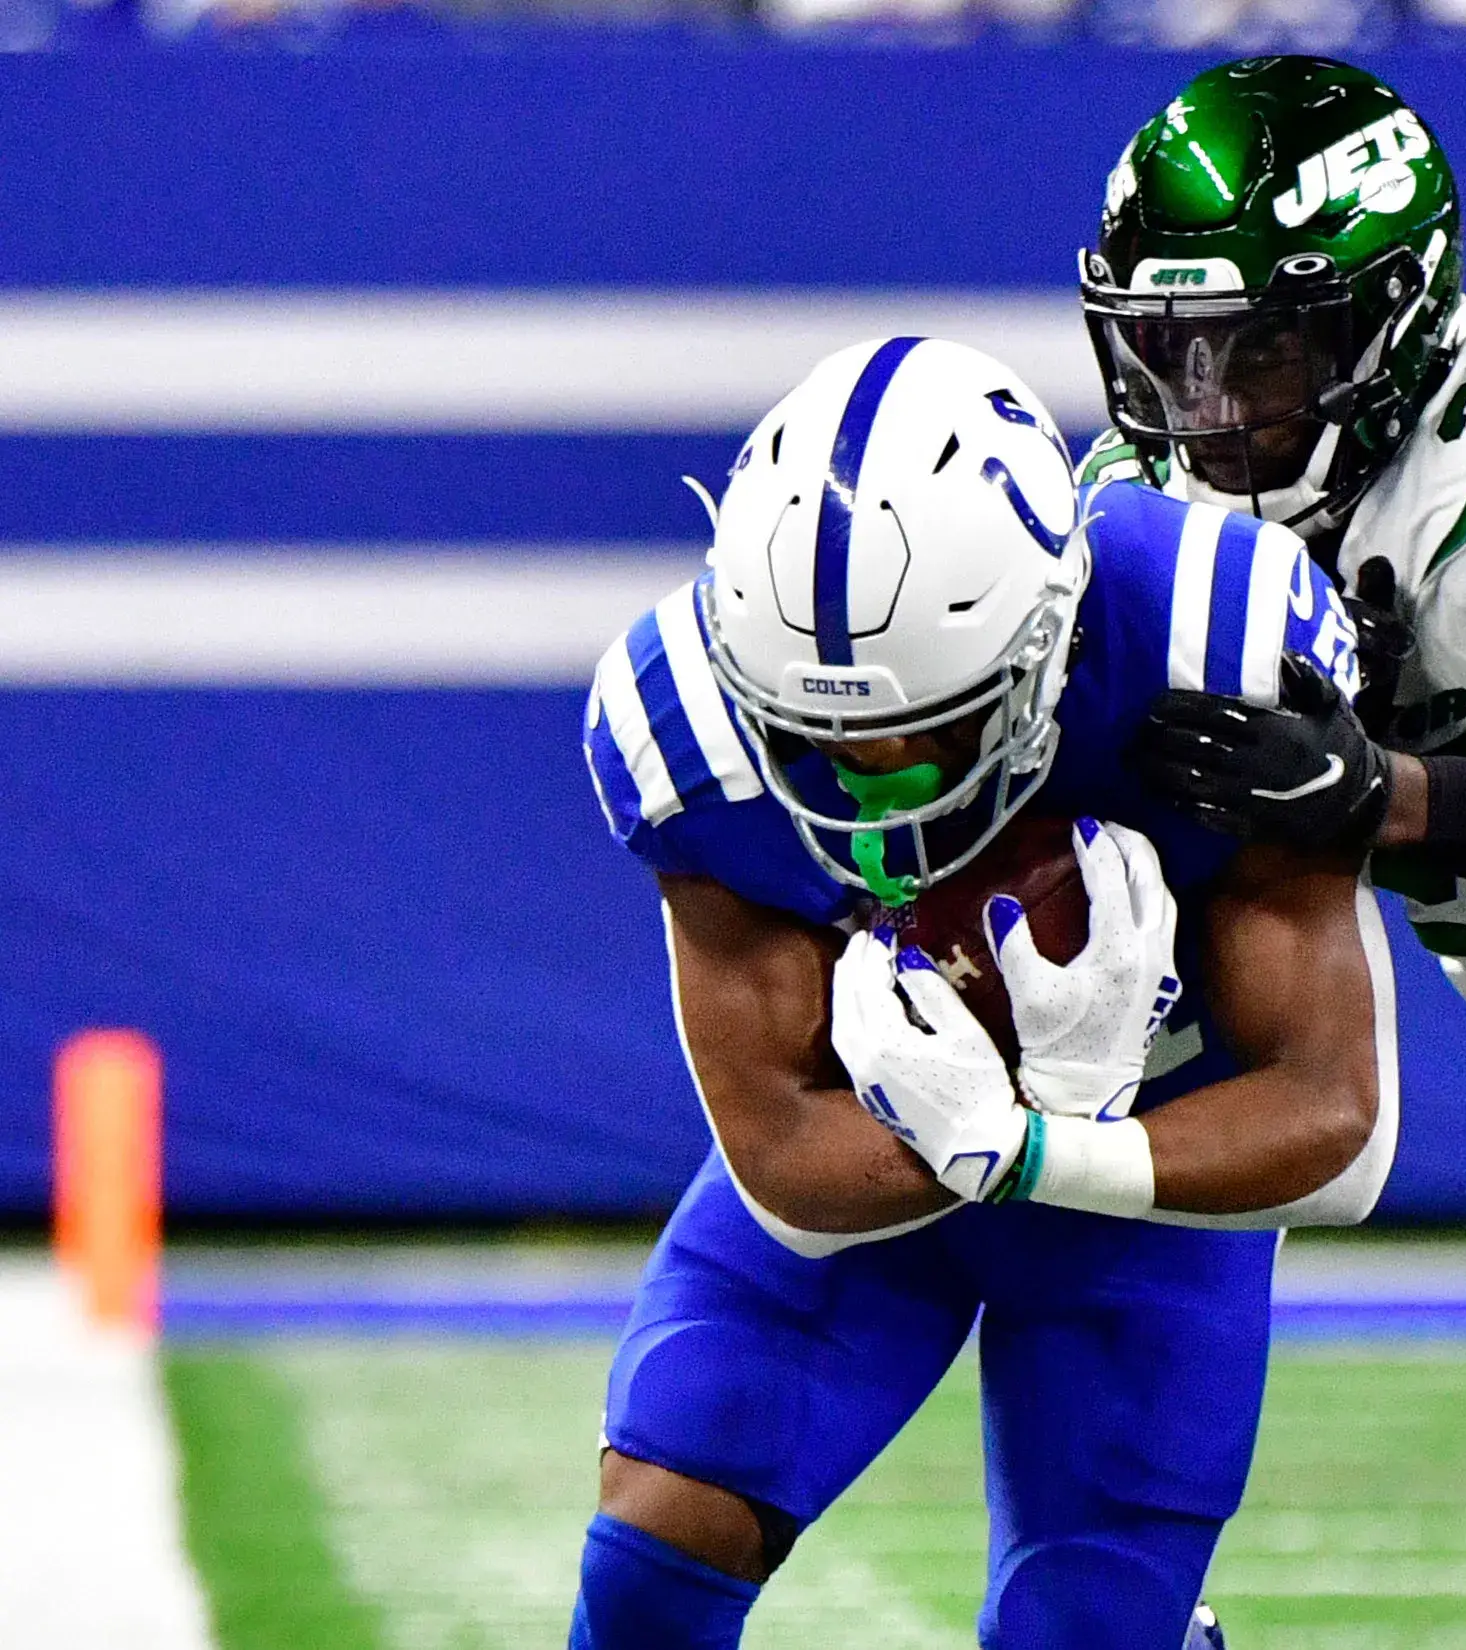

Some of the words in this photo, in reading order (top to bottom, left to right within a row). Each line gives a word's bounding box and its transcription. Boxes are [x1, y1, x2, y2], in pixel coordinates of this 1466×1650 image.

[1272, 107, 1431, 229] JETS
[1149, 267, 1208, 286] JETS
[802, 677, 872, 697] COLTS
